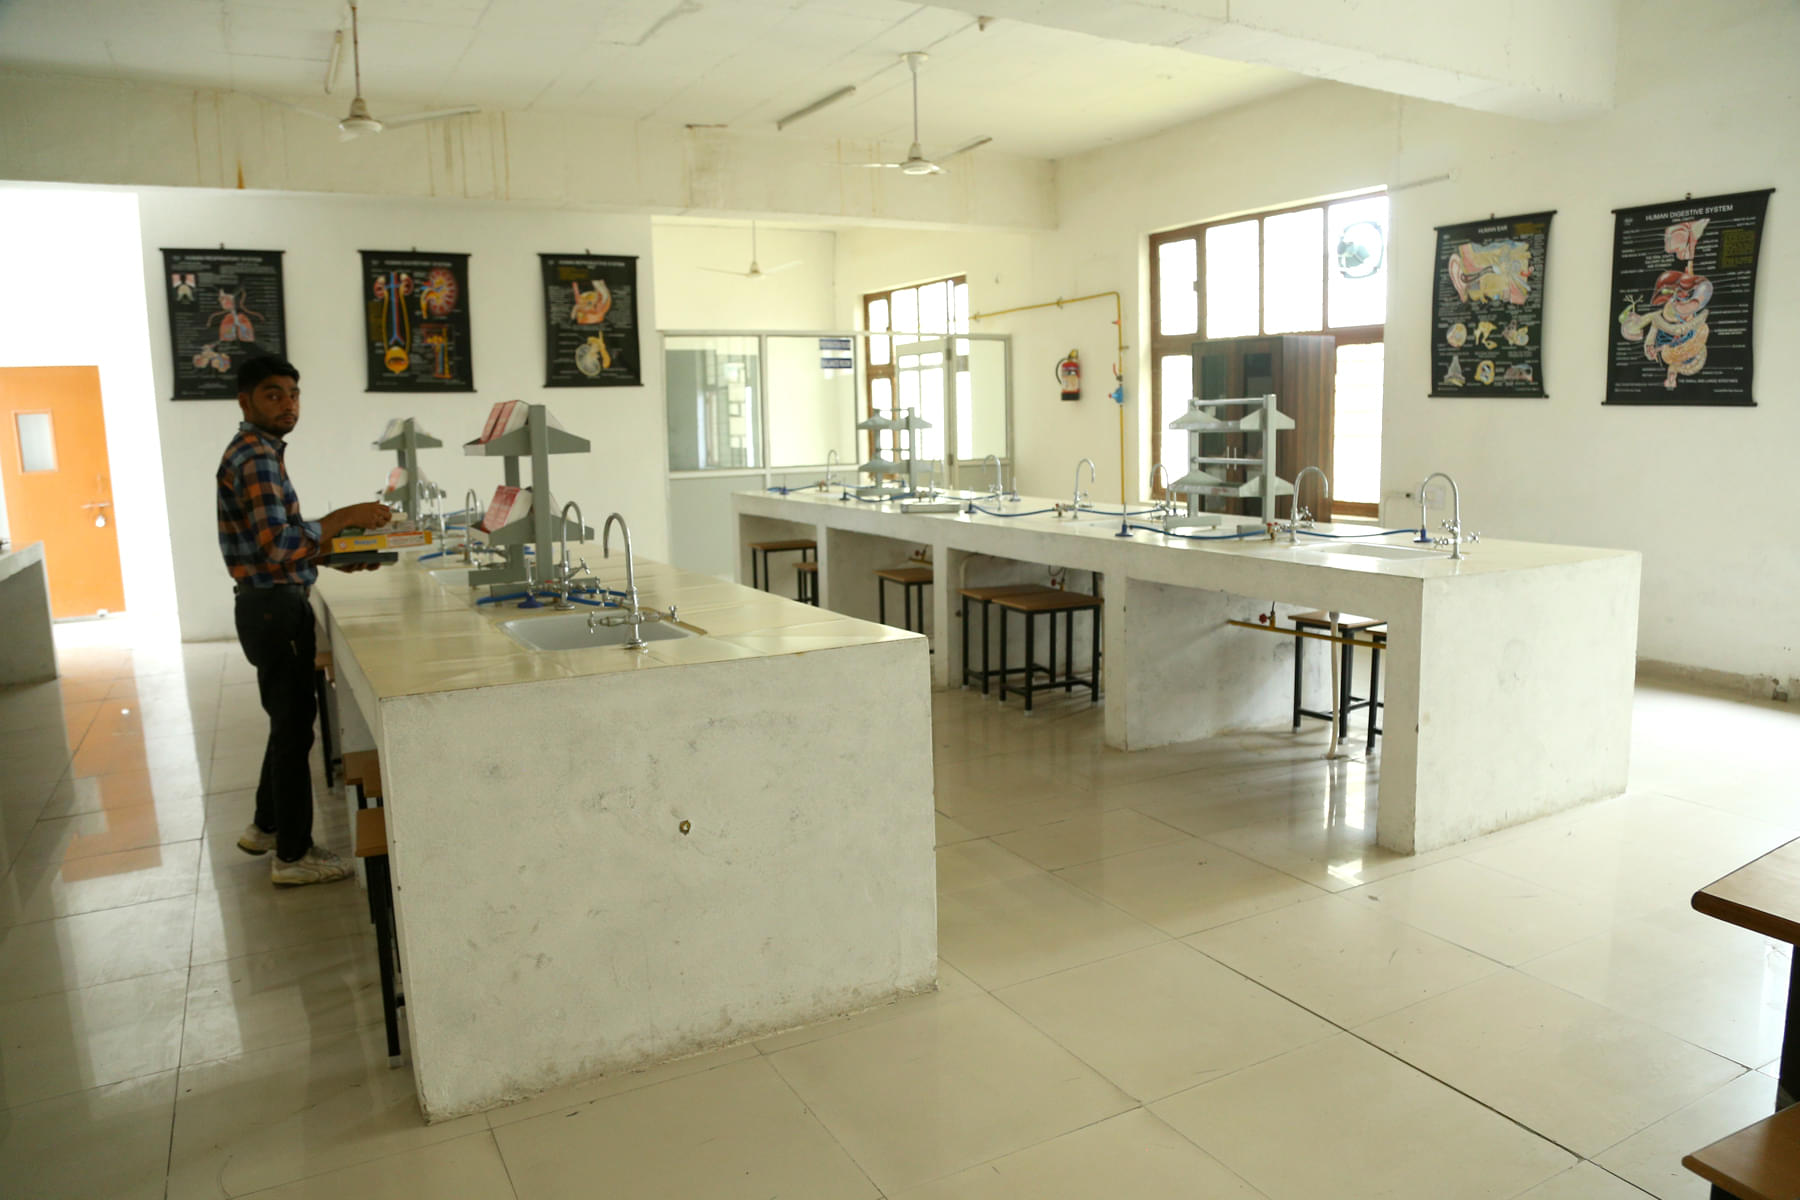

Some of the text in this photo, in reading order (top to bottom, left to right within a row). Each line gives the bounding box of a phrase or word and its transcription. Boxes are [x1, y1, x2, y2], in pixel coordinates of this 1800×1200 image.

[1645, 212, 1669, 221] HUMAN
[1669, 208, 1704, 218] DIGESTIVE
[1704, 204, 1734, 215] SYSTEM
